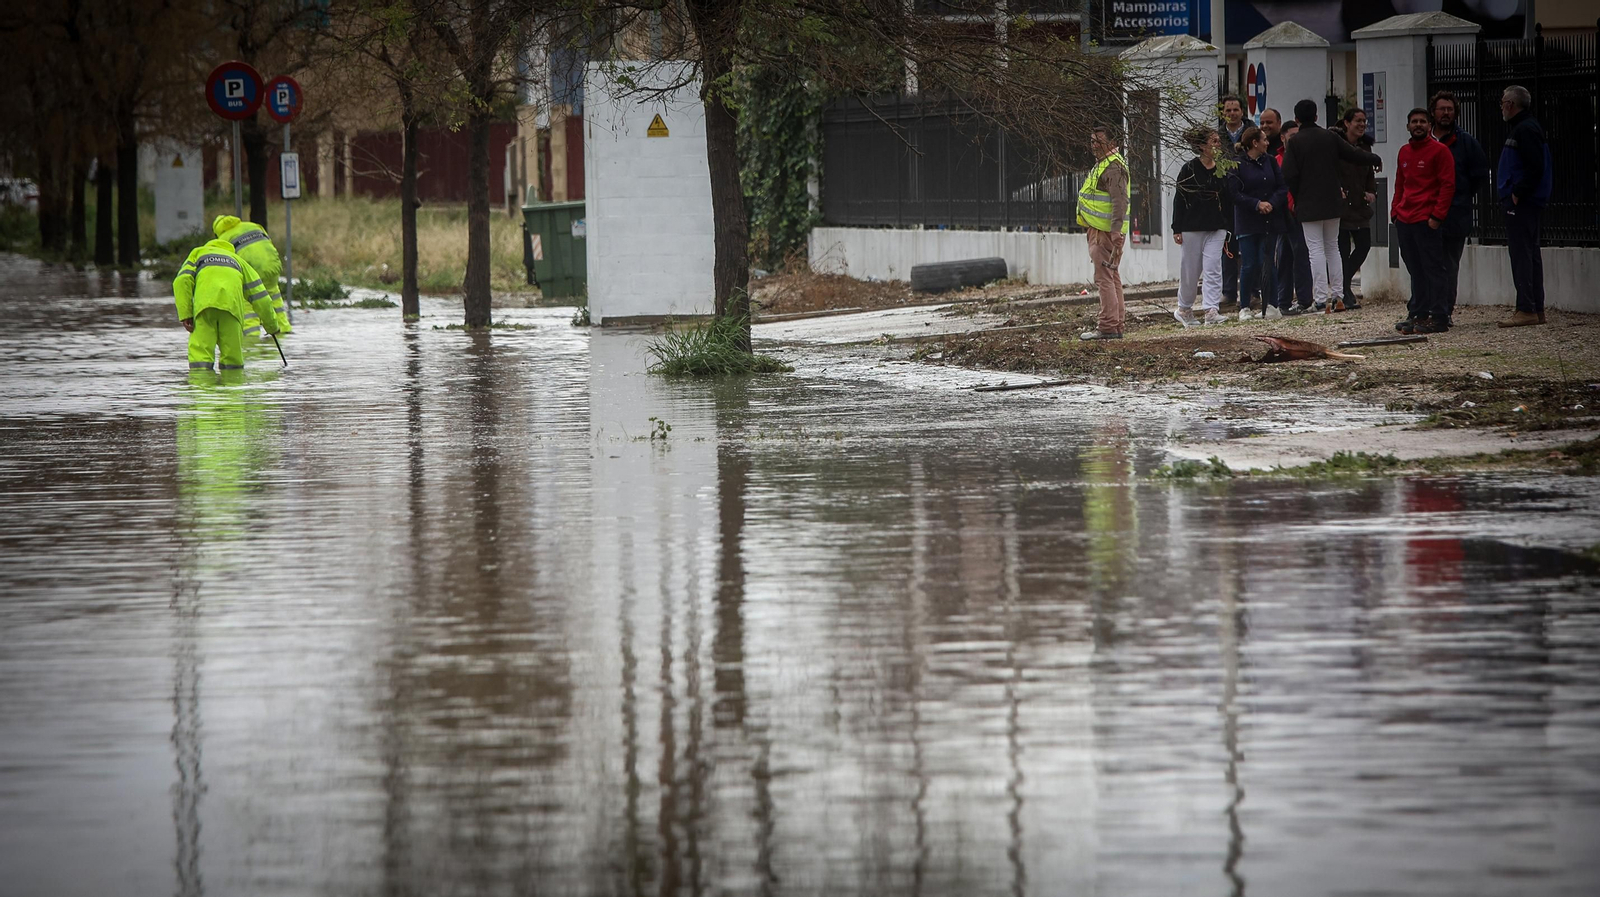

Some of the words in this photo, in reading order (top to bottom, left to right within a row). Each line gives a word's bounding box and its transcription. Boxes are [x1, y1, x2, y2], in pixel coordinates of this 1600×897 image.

[1113, 1, 1187, 14] Mamparas
[1114, 15, 1189, 28] Accesorios
[228, 81, 241, 96] P
